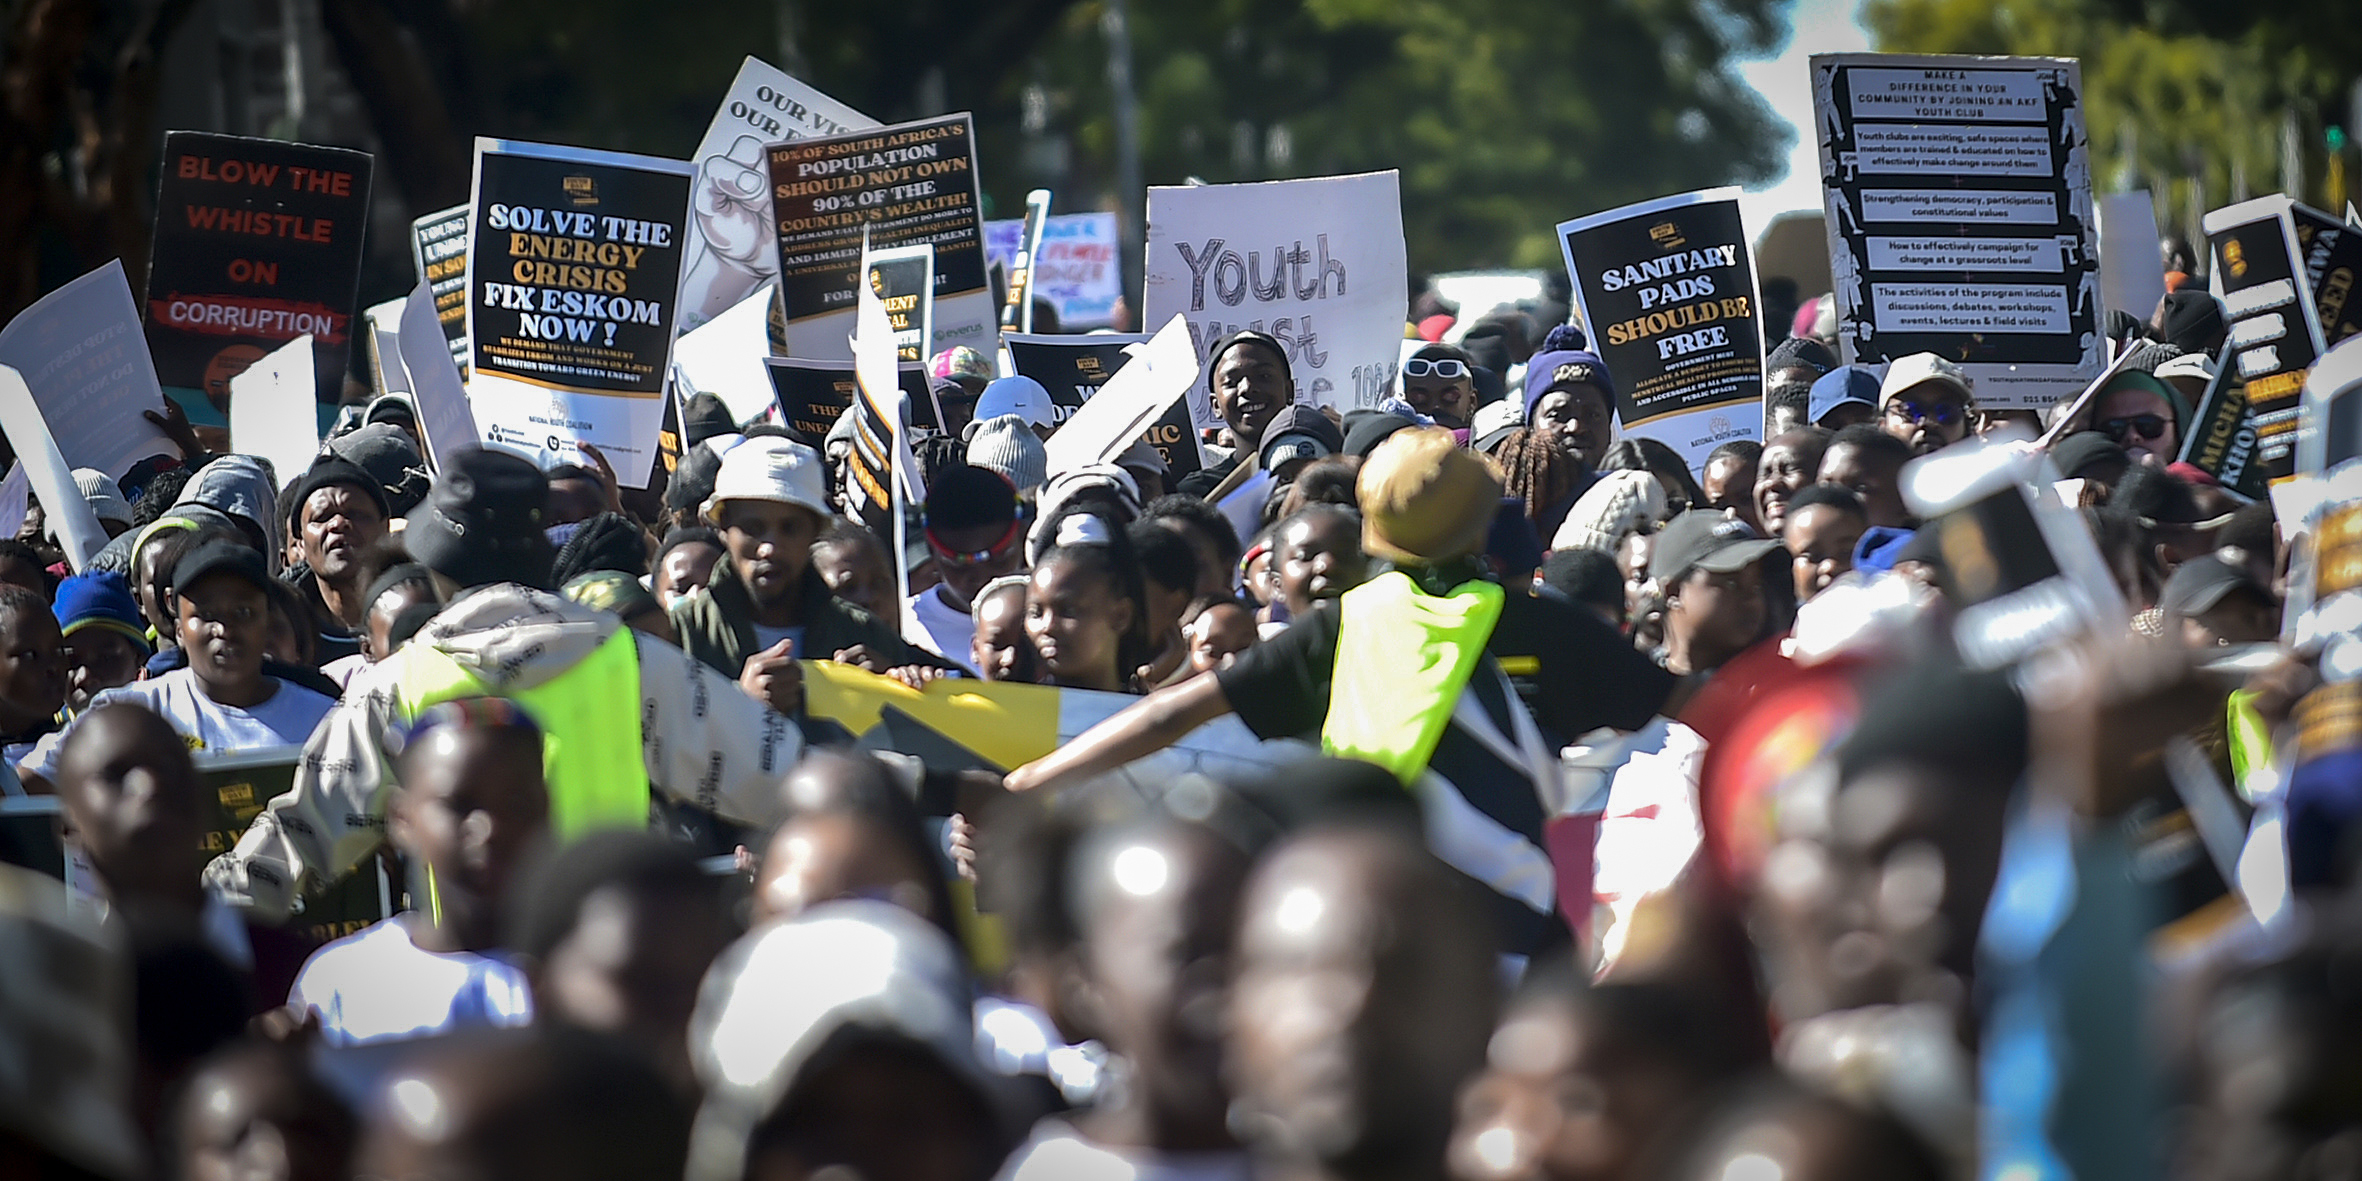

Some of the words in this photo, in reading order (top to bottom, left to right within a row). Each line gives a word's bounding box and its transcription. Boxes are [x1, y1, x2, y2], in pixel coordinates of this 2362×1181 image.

[1889, 82, 1958, 93] DIFFERENCE
[1962, 84, 1973, 93] IN
[1977, 84, 2007, 94] YOUR
[1924, 70, 1956, 81] MAKE
[1959, 71, 1967, 80] A
[756, 86, 807, 121] OUR
[1858, 94, 1926, 105] COMMUNITY
[1930, 96, 1944, 105] BY
[1949, 96, 1994, 106] JOINING
[1997, 98, 2013, 107] AN
[2017, 98, 2038, 107] AKF
[1915, 107, 1952, 118] YOUTH
[1955, 108, 1985, 118] CLUB
[730, 101, 781, 137] OUR
[772, 150, 800, 163] 10%
[803, 147, 825, 159] OF
[828, 138, 884, 156] SOUTH
[888, 124, 964, 147] AFRICA'S
[1857, 131, 1884, 141] Youth
[1886, 132, 1910, 142] clubs
[1911, 134, 1925, 142] are
[1927, 132, 1966, 145] exciting,
[1967, 133, 1987, 143] safe
[1989, 135, 2020, 146] spaces
[2021, 134, 2049, 144] where
[1860, 144, 1905, 154] members
[1904, 146, 1917, 154] are
[1919, 145, 1950, 154] trained
[1961, 145, 2003, 155] educated
[2005, 148, 2016, 156] on
[2017, 147, 2035, 156] how
[2037, 148, 2047, 156] to
[798, 143, 938, 177] POPULATION
[1872, 156, 1921, 168] effectively
[1922, 157, 1947, 167] make
[1948, 158, 1980, 169] change
[1982, 158, 2013, 168] around
[2014, 159, 2038, 168] them
[178, 155, 279, 187] BLOW
[289, 166, 352, 197] THE
[776, 174, 865, 199] SHOULD
[869, 165, 912, 185] NOT
[917, 156, 968, 177] OWN
[813, 194, 855, 212] 90%
[859, 188, 889, 206] OF
[891, 180, 936, 200] THE
[1863, 194, 1930, 206] Strengthening
[1932, 195, 1985, 207] democracy,
[1986, 196, 2046, 207] participation
[187, 205, 334, 243] WHISTLE
[780, 207, 883, 233] COUNTRY'S
[885, 192, 969, 218] WEALTH!
[781, 235, 795, 243] WE
[797, 229, 834, 240] DEMAND
[921, 213, 932, 222] DO
[934, 209, 960, 220] MORE
[961, 207, 973, 215] TO
[913, 216, 974, 234] INEQUALITY
[1912, 208, 1977, 218] constitutional
[1979, 209, 2008, 218] values
[489, 204, 595, 237] SOLVE
[602, 216, 671, 247] THE
[509, 233, 645, 269] ENERGY
[786, 255, 812, 265] AND
[902, 228, 974, 248] IMPLEMENT
[1889, 241, 1909, 251] How
[1911, 242, 1921, 251] to
[1923, 242, 1975, 253] effectively
[1977, 243, 2023, 255] campaign
[2025, 243, 2039, 252] for
[228, 258, 278, 285] ON
[794, 261, 848, 274] UNIVERSAL
[1175, 233, 1347, 312] Youth
[1601, 244, 1736, 292] SANITARY
[1900, 255, 1934, 266] change
[1936, 256, 1946, 265] at
[1956, 256, 2008, 267] grassroots
[2009, 256, 2032, 265] level
[513, 259, 627, 293] CRISIS
[484, 282, 535, 311] FIX
[540, 289, 661, 326] ESKOM
[823, 290, 854, 303] FOR
[1638, 275, 1716, 310] PADS
[1878, 287, 1897, 297] The
[1900, 287, 1946, 297] activities
[1949, 288, 1960, 297] of
[1963, 288, 1978, 298] the
[1981, 289, 2023, 301] program
[2025, 289, 2062, 299] include
[170, 301, 332, 335] CORRUPTION
[1888, 301, 1950, 313] discussions,
[1952, 303, 1996, 314] debates,
[1999, 303, 2056, 315] workshops,
[519, 312, 596, 343] NOW
[1607, 301, 1720, 346] SHOULD
[1723, 296, 1751, 320] BE
[1900, 316, 1938, 327] events,
[1939, 316, 1982, 326] lectures
[1984, 316, 1991, 326] &
[1993, 316, 2016, 326] field
[2019, 317, 2047, 326] visits
[500, 337, 513, 347] WE
[513, 339, 546, 350] DEMAND
[548, 342, 571, 353] THAT
[573, 344, 634, 360] GOVERNMENT
[1656, 326, 1729, 360] FREE
[492, 356, 537, 371] TRANSITION
[538, 362, 575, 374] TOWARD
[576, 367, 605, 378] GREEN
[607, 370, 642, 383] ENERGY
[526, 351, 554, 361] ESKOM
[555, 354, 574, 363] AND
[576, 356, 608, 367] WORKS
[609, 360, 622, 369] ON
[623, 362, 630, 370] A
[632, 363, 653, 373] JUST
[1665, 354, 1715, 371] GOVERNMENT
[1716, 351, 1734, 359] MUST
[1631, 382, 1674, 399] MENSTRUAL
[1676, 374, 1706, 386] HEALTH
[1635, 373, 1673, 389] ALLOCATE
[1681, 365, 1709, 377] BUDGET
[1636, 397, 1651, 407] AND
[1652, 385, 1696, 405] ACCESSIBLE
[1707, 379, 1720, 388] ALL
[1682, 390, 1709, 403] PUBLIC
[1710, 385, 1737, 395] SPACES
[809, 404, 841, 418] THE
[566, 420, 593, 431] COALITION
[1690, 437, 1714, 448] NATIONAL
